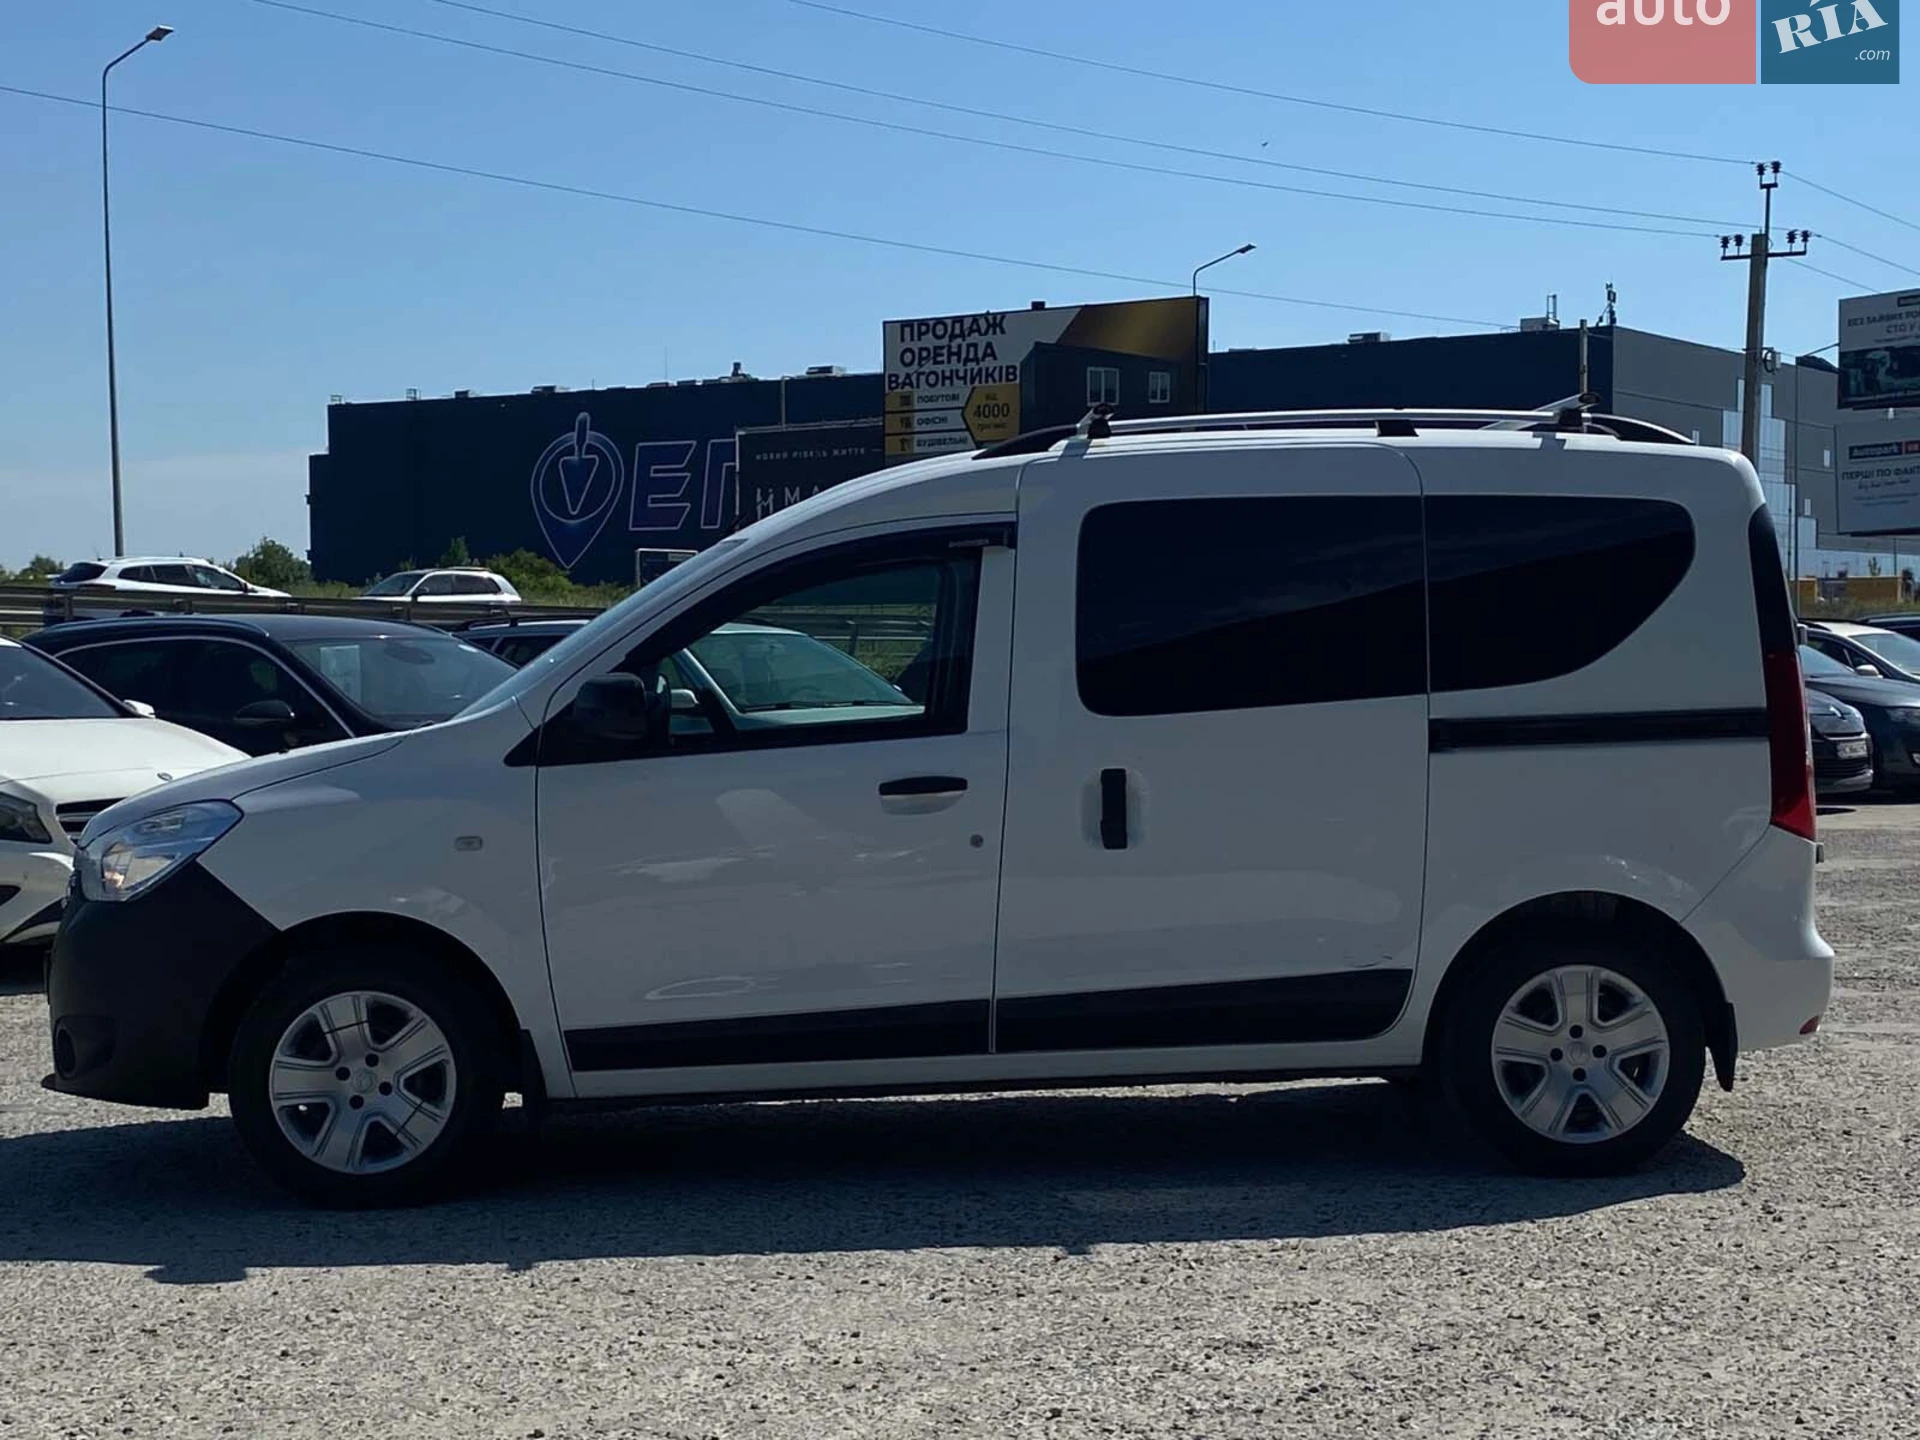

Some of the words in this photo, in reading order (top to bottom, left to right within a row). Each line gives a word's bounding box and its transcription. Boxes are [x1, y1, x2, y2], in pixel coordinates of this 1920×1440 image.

[900, 314, 1006, 343] ПРОДАЖ
[900, 341, 998, 368] ОРЕНДА
[887, 364, 1018, 390] ВАГОНЧИКІВ
[973, 402, 1010, 419] 4000
[1876, 467, 1892, 479] ПО
